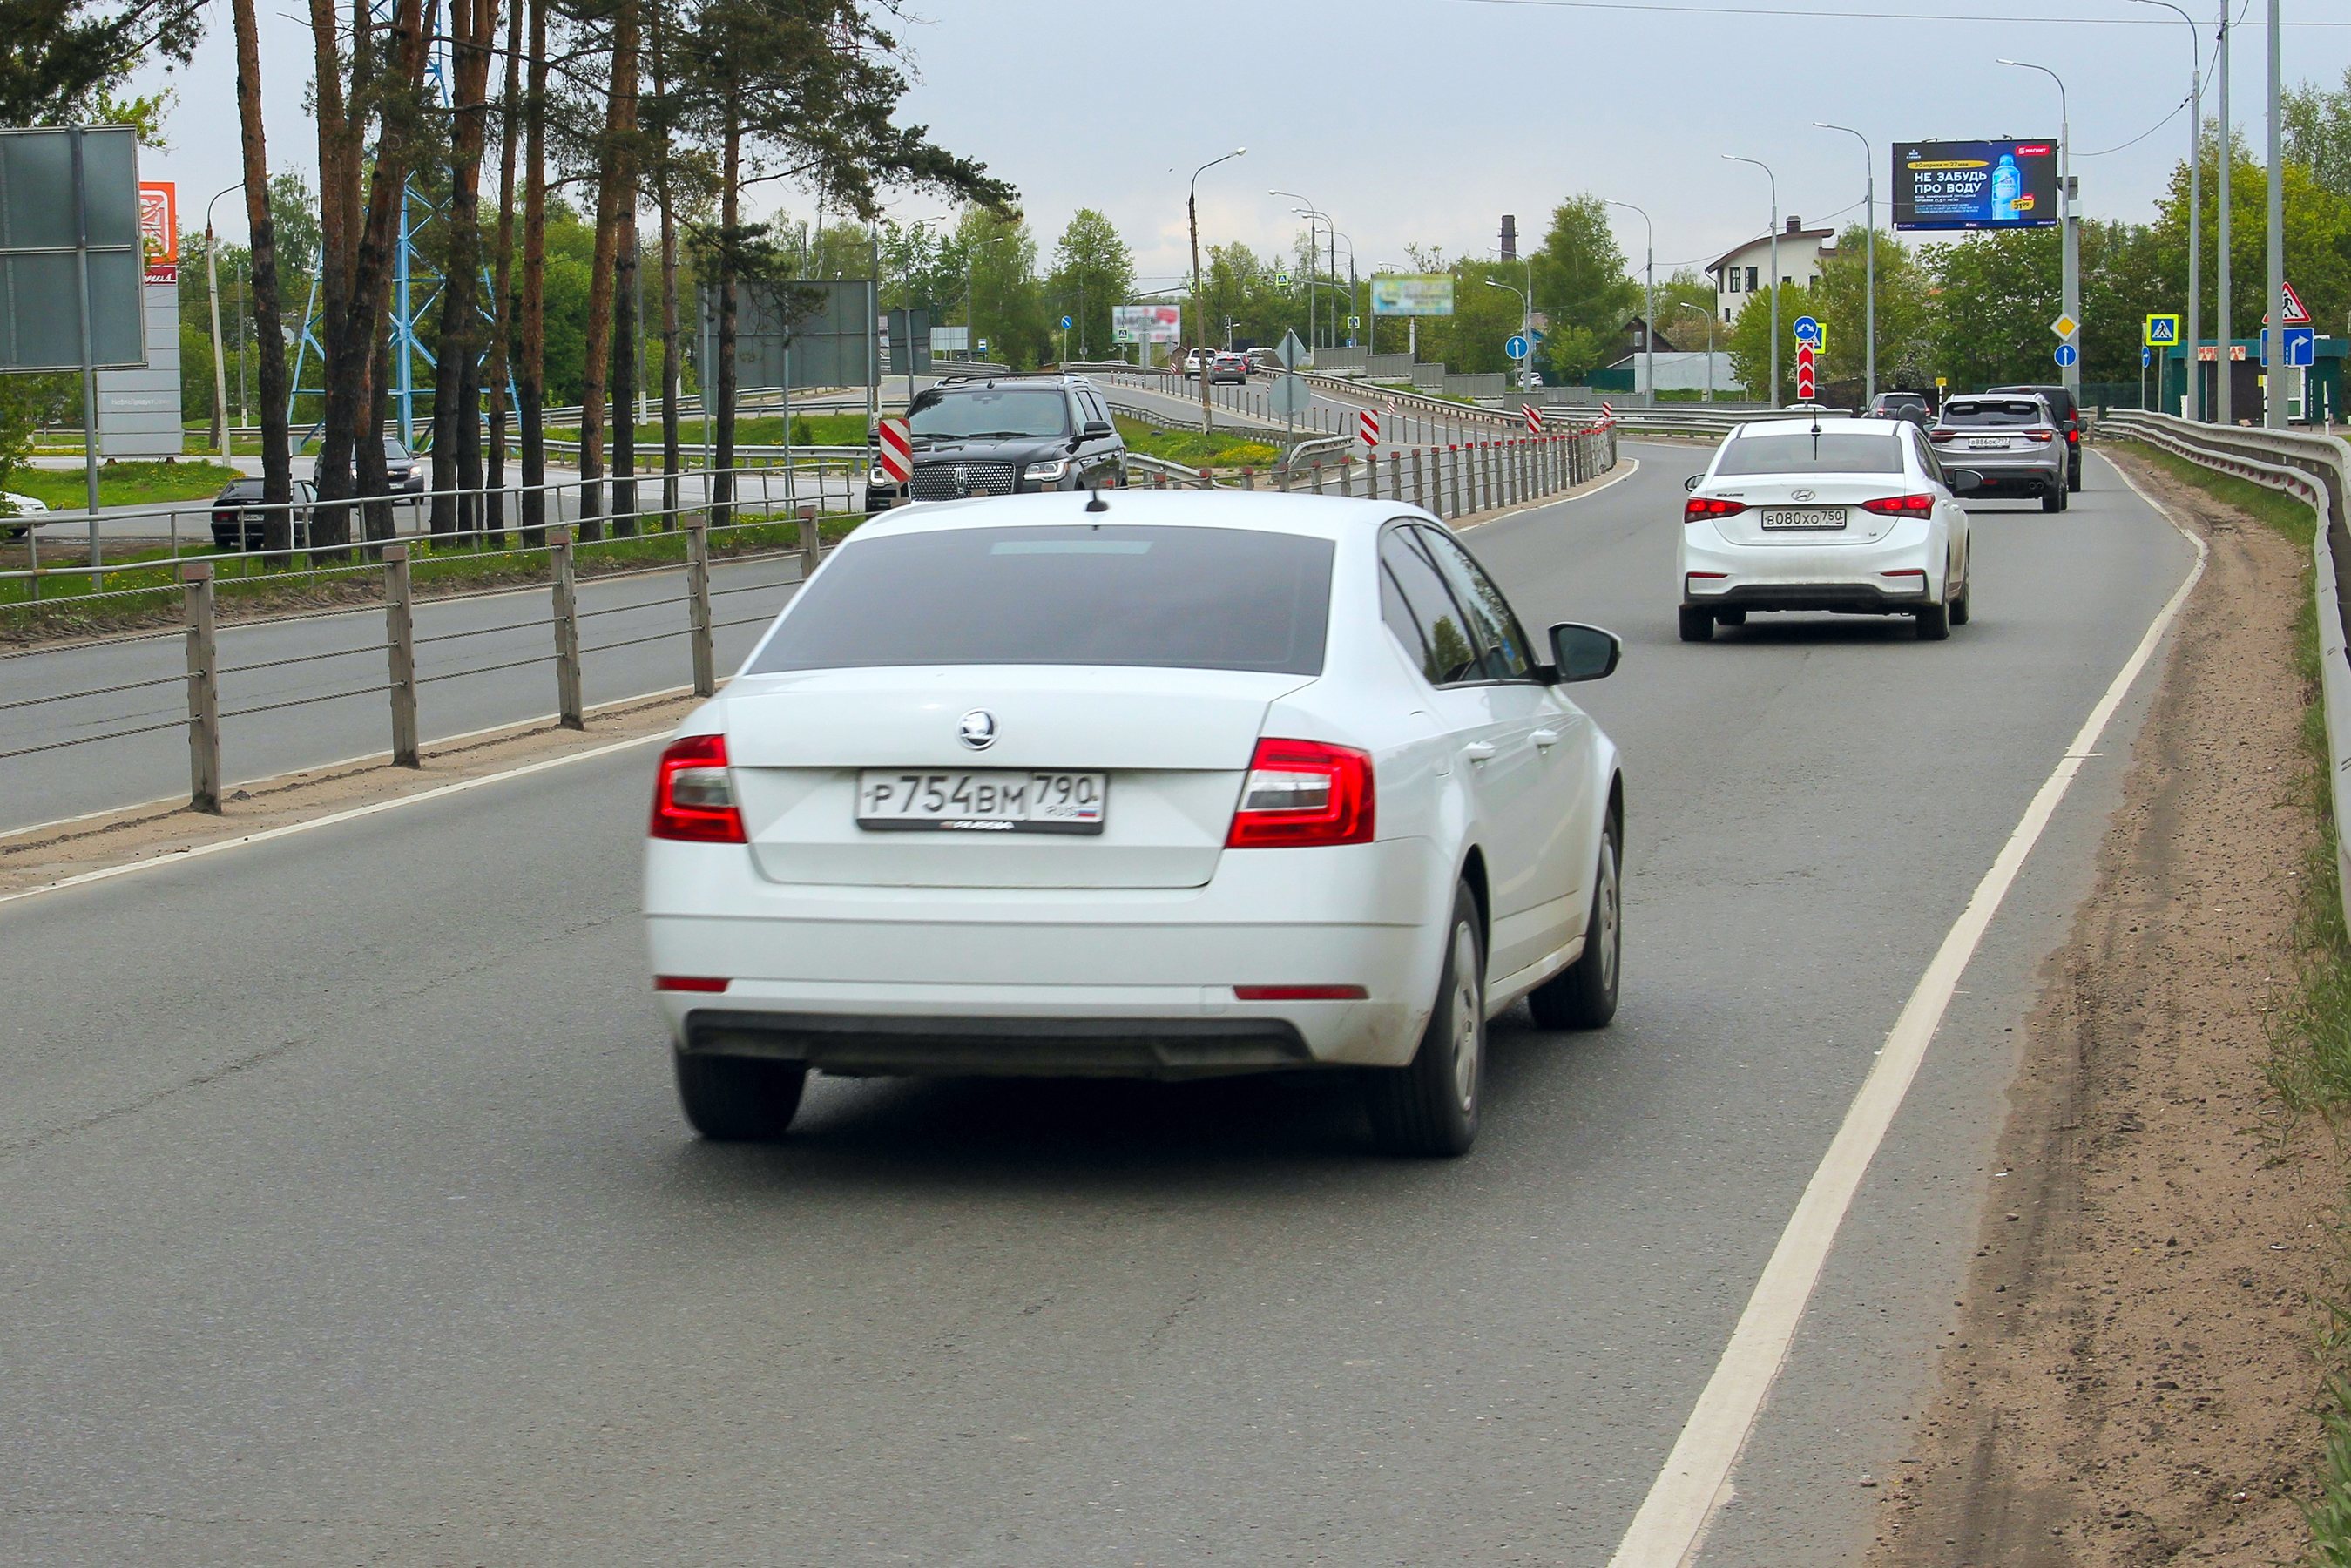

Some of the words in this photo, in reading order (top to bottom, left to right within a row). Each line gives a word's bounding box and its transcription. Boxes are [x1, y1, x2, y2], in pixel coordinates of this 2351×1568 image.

[1915, 172, 1932, 183] НЕ
[1936, 171, 1988, 182] ЗАБУДЬ
[1915, 184, 1942, 194] ПРО
[1946, 182, 1982, 193] ВОДУ
[1767, 511, 1820, 525] В080ХО
[1821, 510, 1842, 521] 750
[872, 775, 1025, 814] Р754ВМ
[1033, 775, 1094, 805] 790
